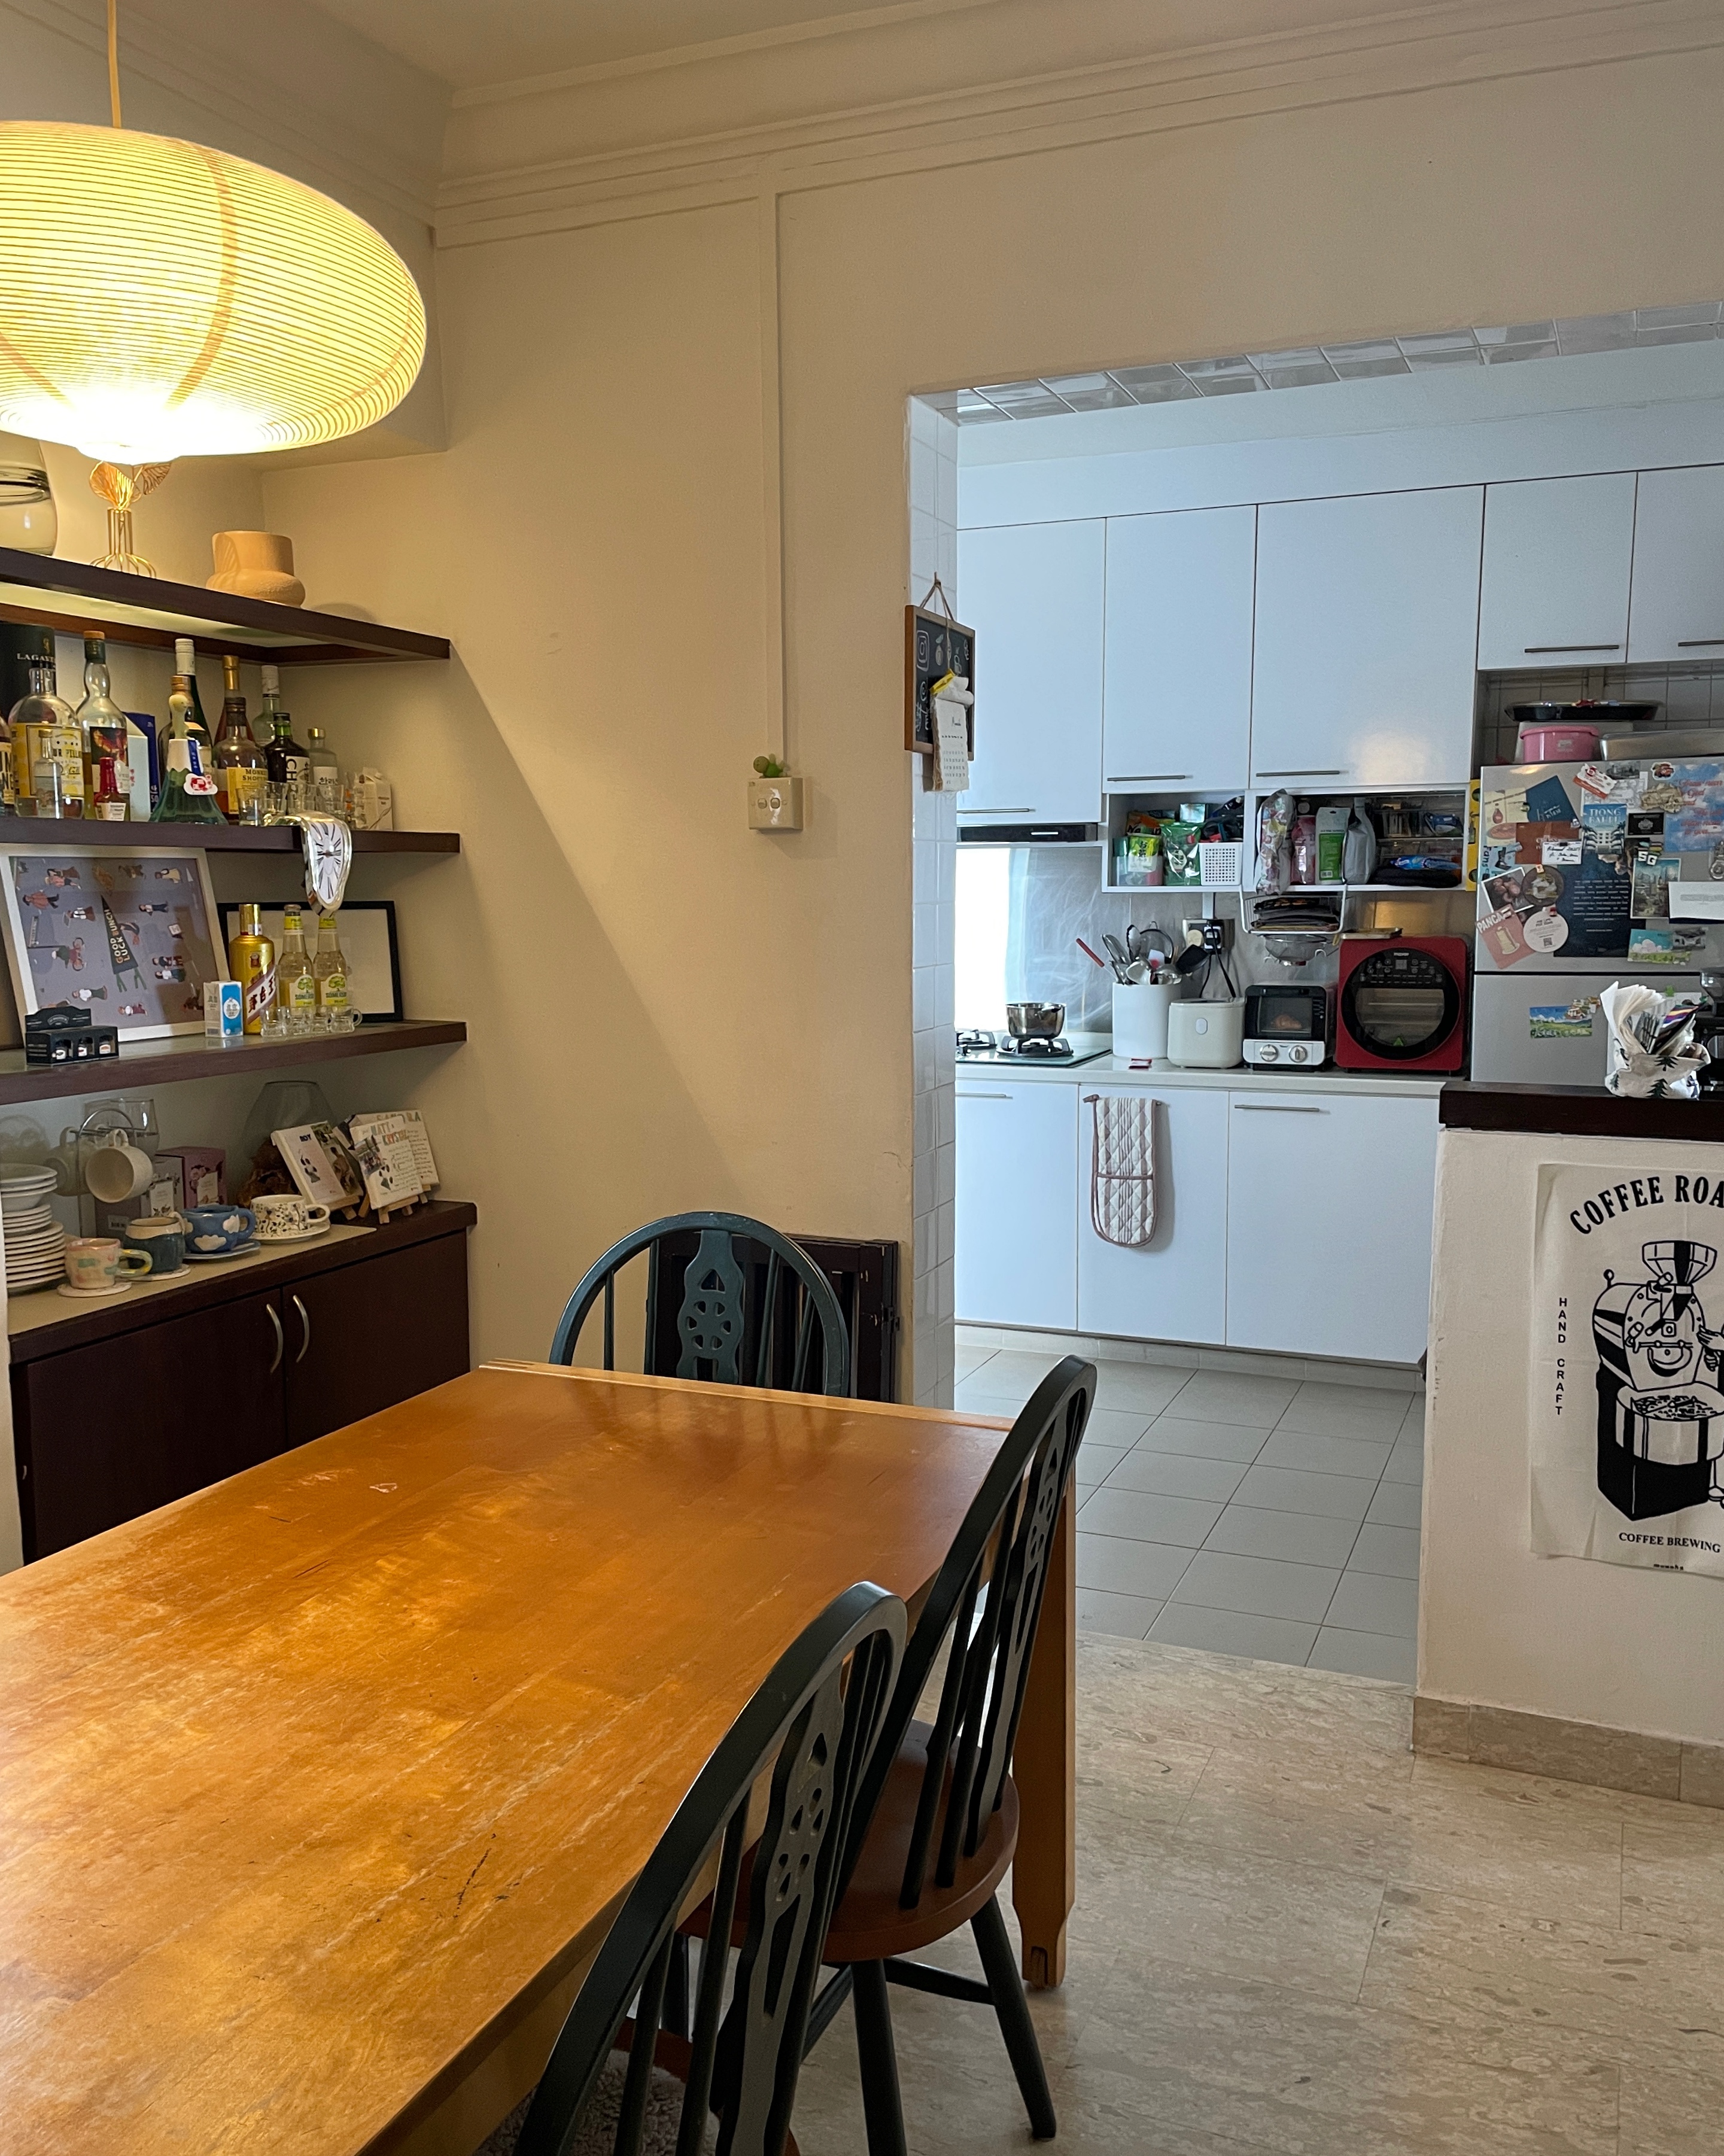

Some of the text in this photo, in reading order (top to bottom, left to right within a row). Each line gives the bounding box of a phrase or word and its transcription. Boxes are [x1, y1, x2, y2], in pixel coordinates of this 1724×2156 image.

[110, 938, 123, 964] GOOD
[117, 936, 130, 962] LUCK
[1570, 1175, 1724, 1234] COFFEE ROA
[1555, 1297, 1567, 1415] HAND CRAFT
[1619, 1532, 1721, 1553] COFFEE BREWING
